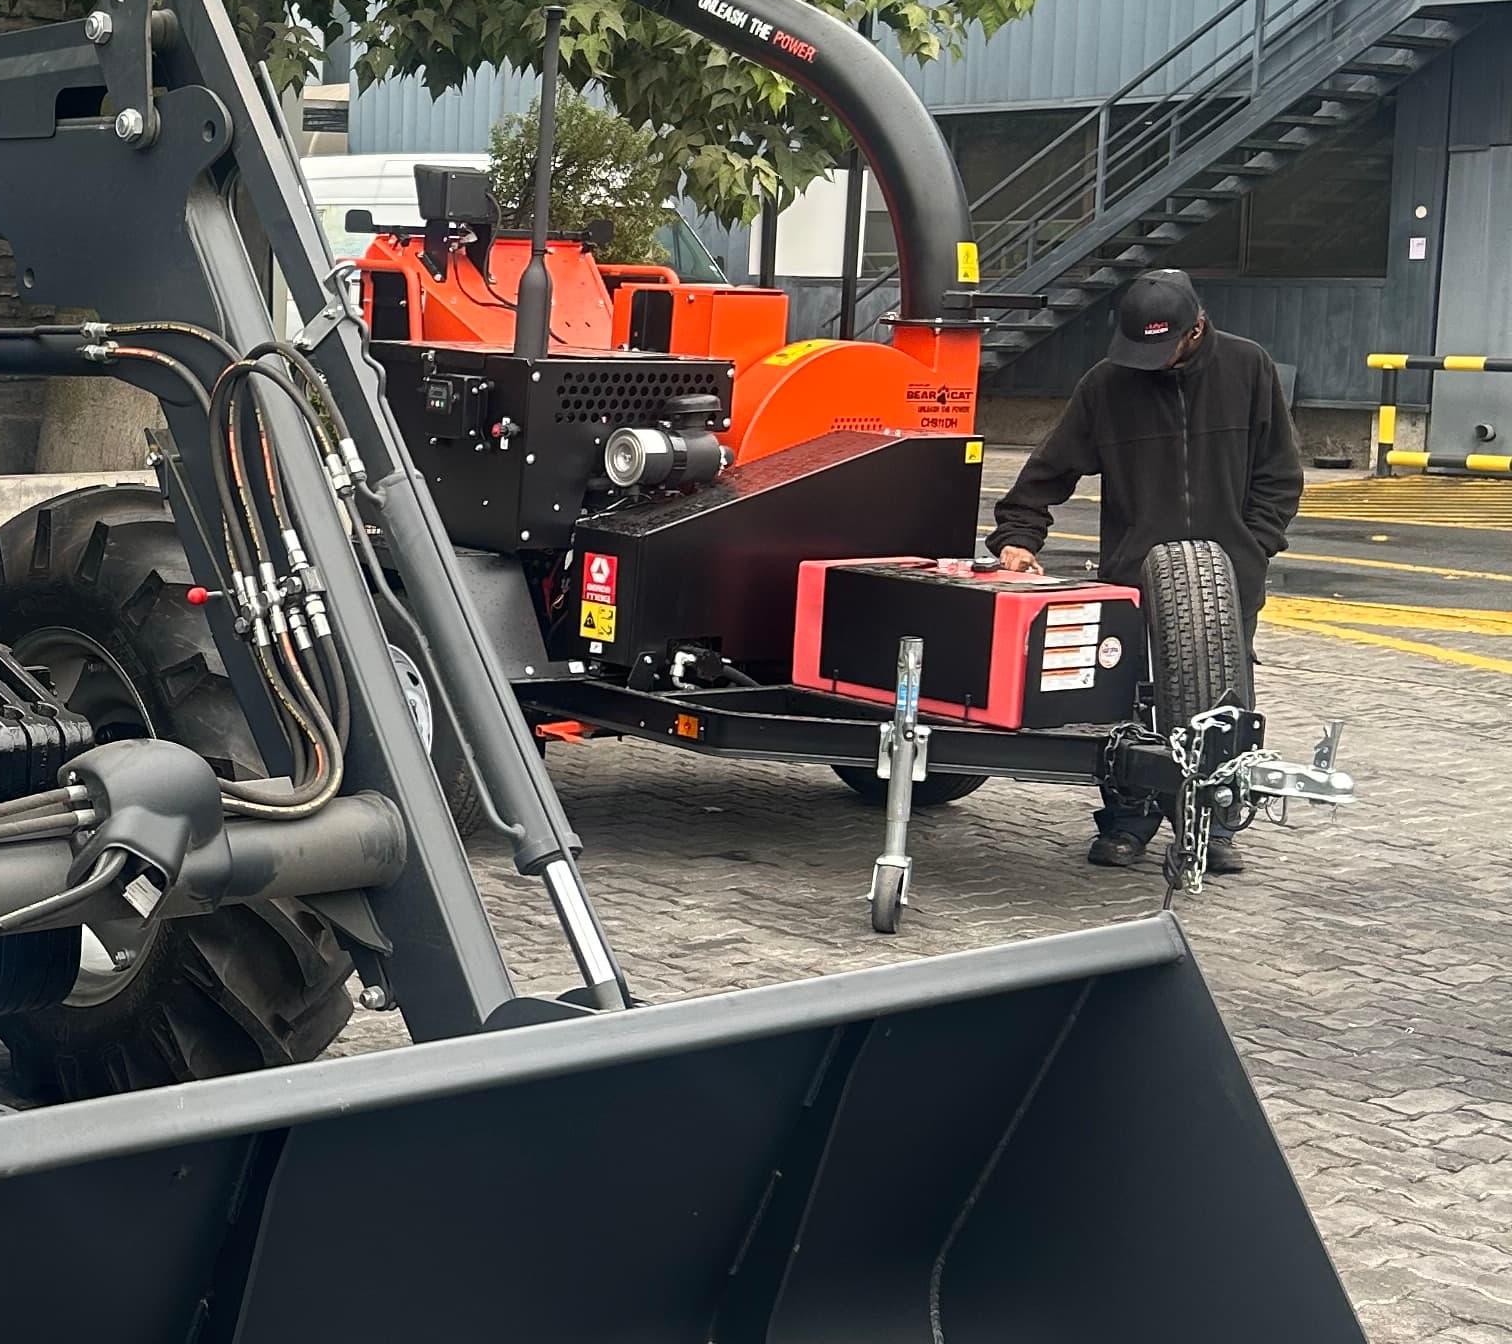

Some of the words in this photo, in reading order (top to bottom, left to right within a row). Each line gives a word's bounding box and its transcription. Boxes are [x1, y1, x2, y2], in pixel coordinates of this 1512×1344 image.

[749, 17, 774, 41] THE
[906, 390, 936, 400] BEAR
[951, 391, 974, 400] CAT
